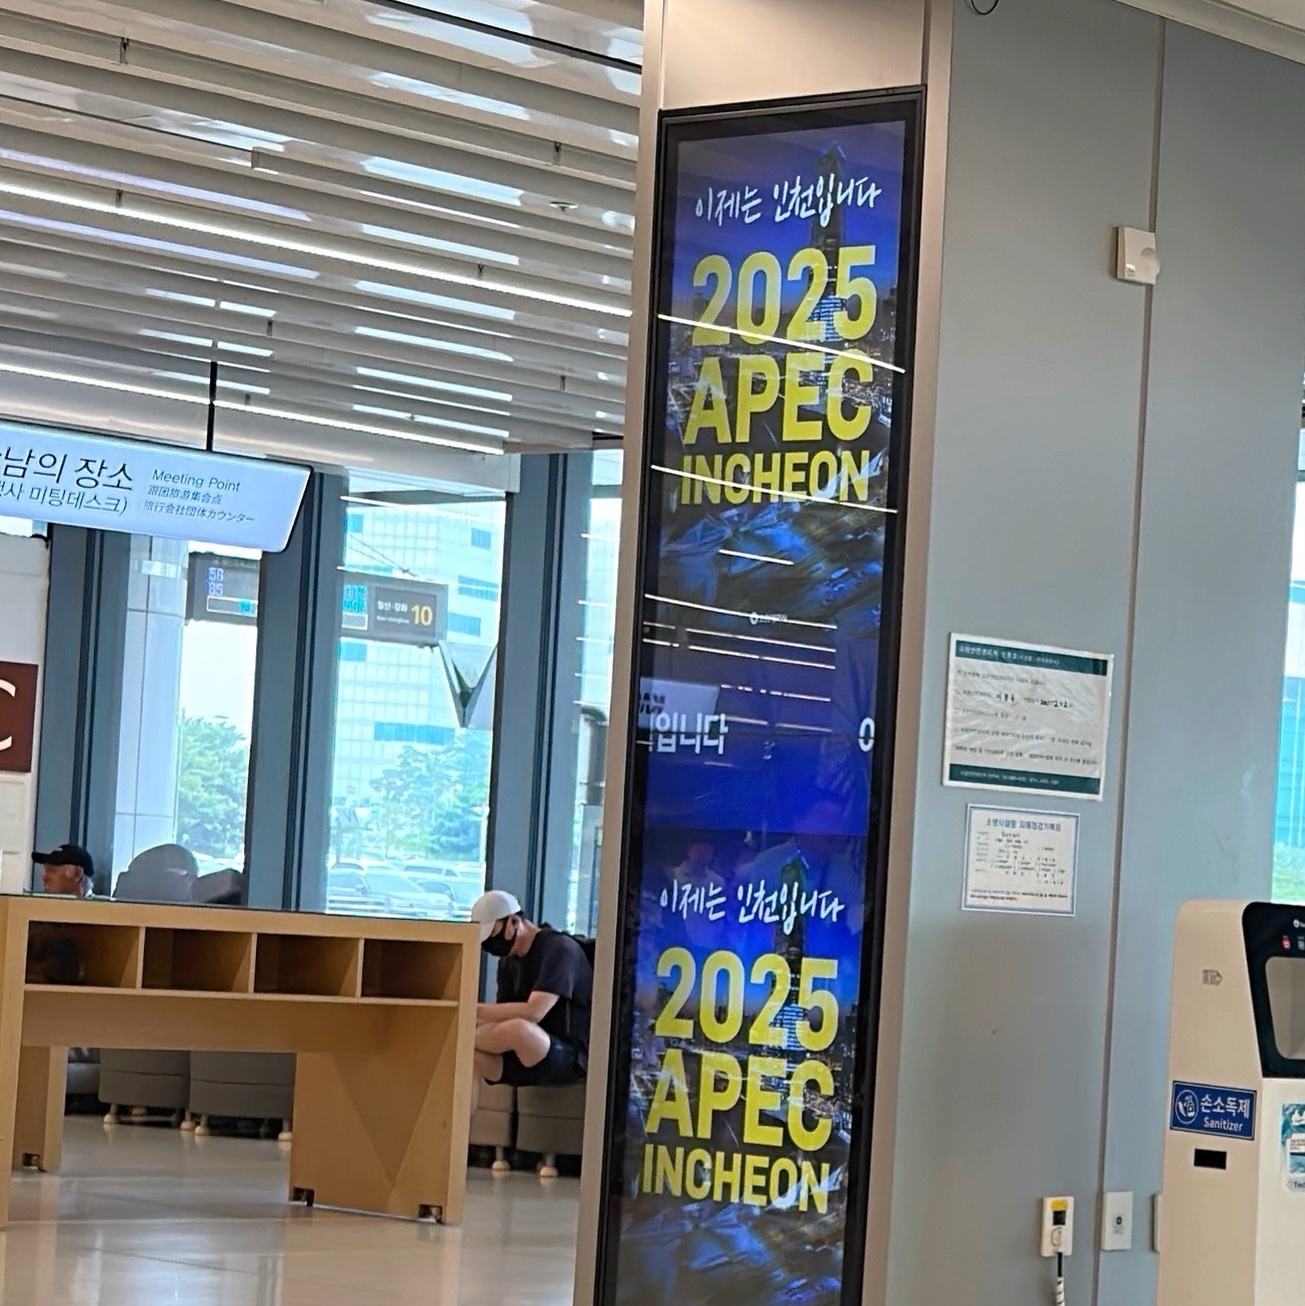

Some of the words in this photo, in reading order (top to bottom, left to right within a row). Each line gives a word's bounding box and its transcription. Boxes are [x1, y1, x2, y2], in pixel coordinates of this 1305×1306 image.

[695, 186, 762, 226] 이제는
[772, 173, 883, 228] 인천입니다
[691, 245, 877, 346] 2025
[683, 348, 874, 444] APEC
[0, 447, 67, 484] 남의
[75, 458, 133, 491] 장소
[152, 469, 204, 488] Meeting
[208, 477, 240, 492] Point
[681, 450, 870, 505] INCHEON
[29, 486, 128, 516] 미팅데스크)
[411, 605, 433, 626] 10
[648, 712, 729, 756] 입니다
[660, 879, 727, 921] 이제는
[737, 879, 845, 935] 인천입니다
[655, 946, 839, 1052] 2025
[644, 1048, 835, 1152] APEC
[1200, 1094, 1250, 1118] 손소독제
[1203, 1117, 1243, 1131] Sanitizer
[642, 1143, 830, 1214] INCHEON
